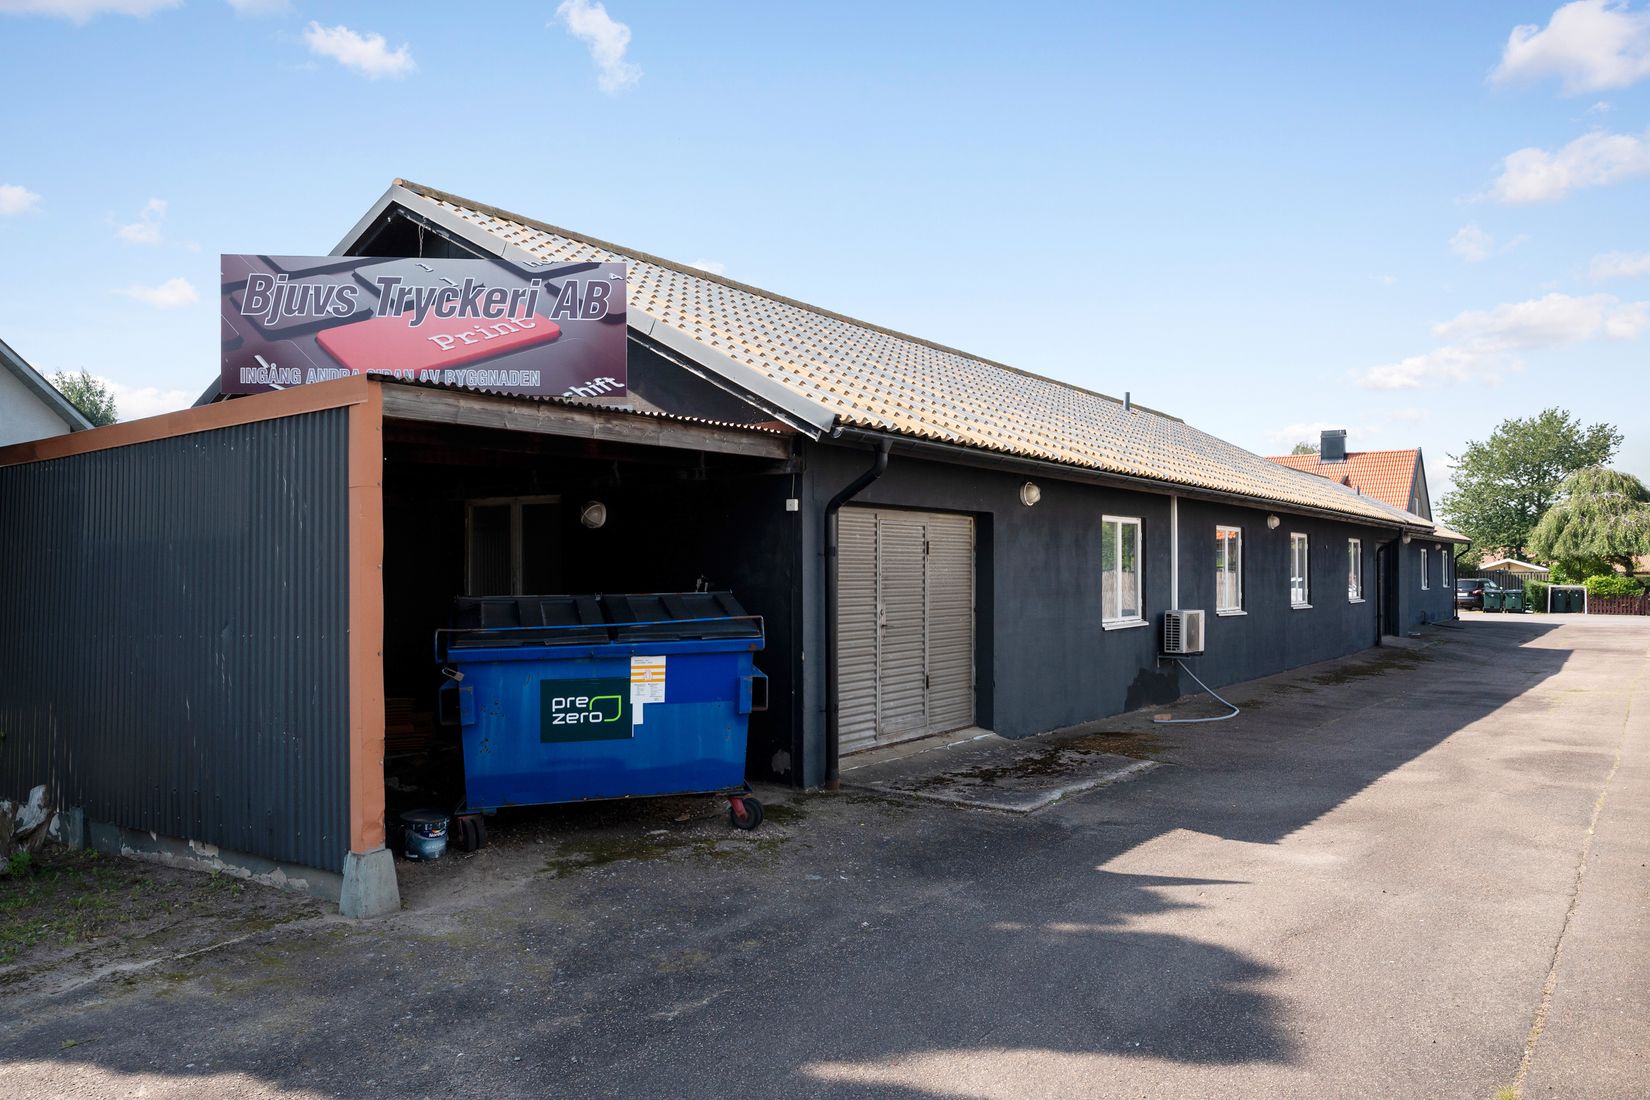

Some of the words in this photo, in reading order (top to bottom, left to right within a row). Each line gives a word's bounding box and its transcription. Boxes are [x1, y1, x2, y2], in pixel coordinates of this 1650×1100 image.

[240, 273, 359, 326] Bjuvs
[375, 277, 542, 328] Tryckeri
[549, 279, 612, 321] AB
[427, 318, 536, 351] Print
[240, 363, 301, 384] INGÅNG
[419, 369, 441, 383] AV
[444, 369, 541, 387] BYGGNADEN
[552, 696, 589, 712] pre
[552, 712, 602, 724] zero
